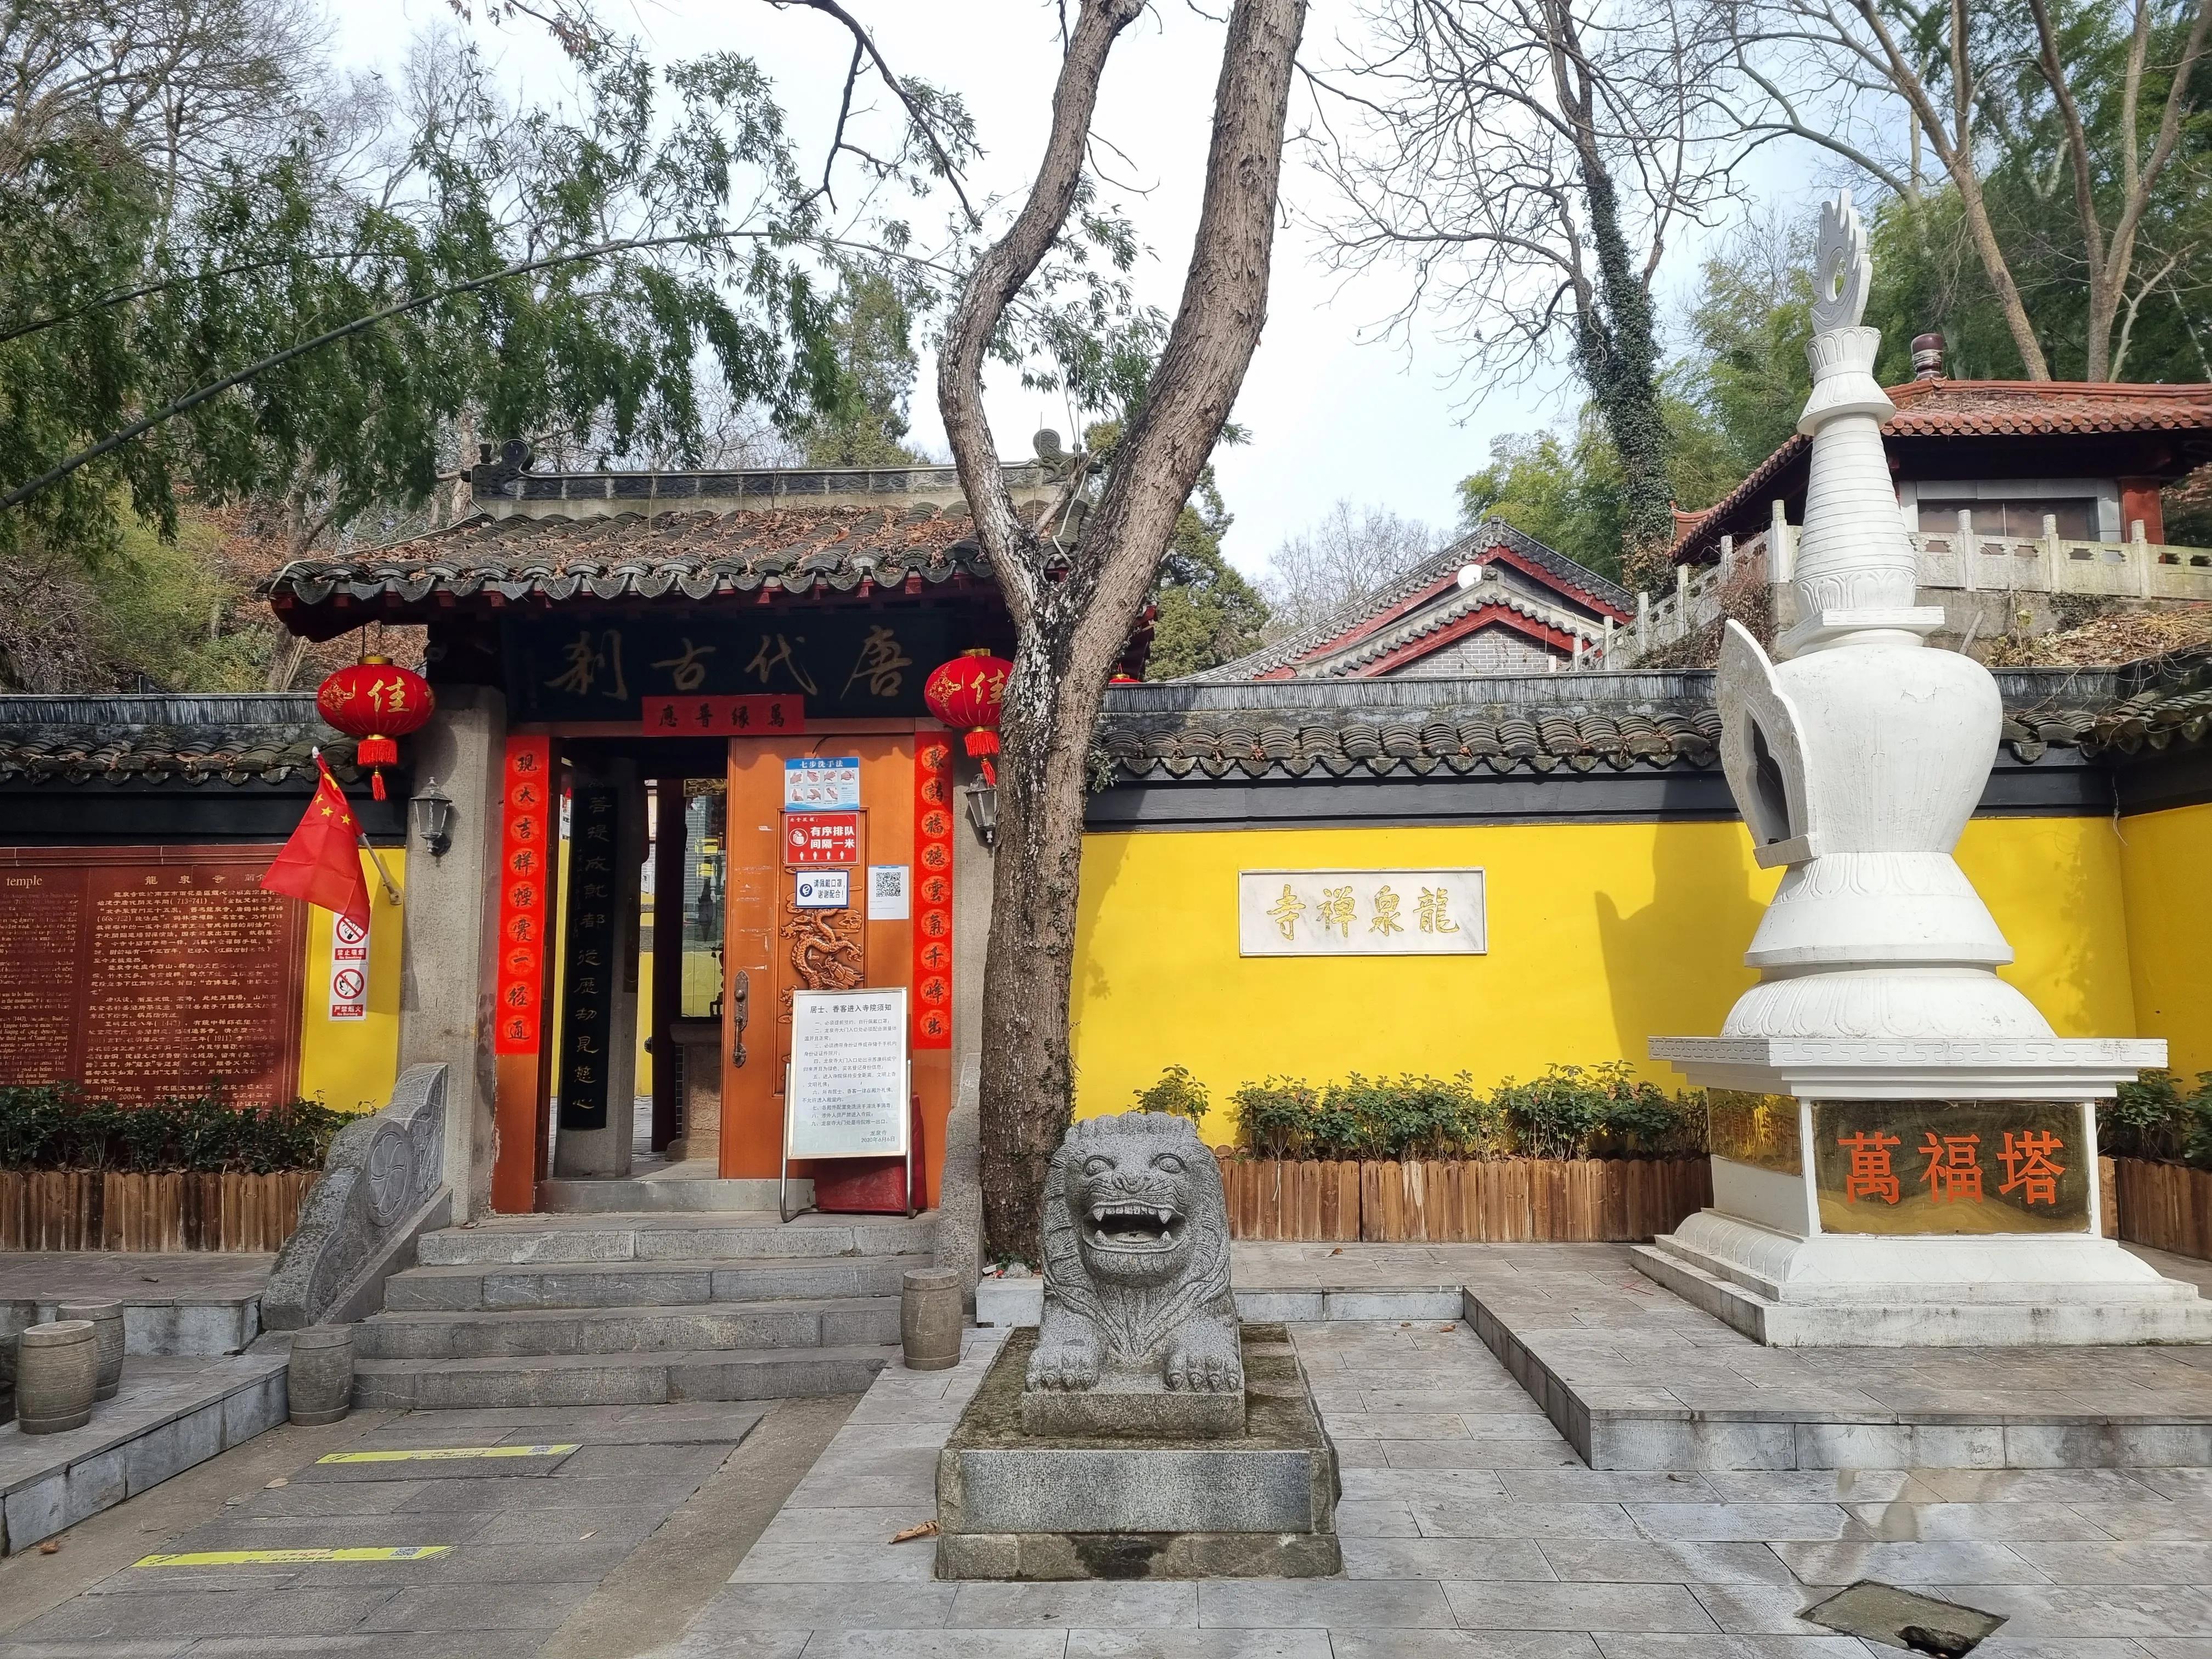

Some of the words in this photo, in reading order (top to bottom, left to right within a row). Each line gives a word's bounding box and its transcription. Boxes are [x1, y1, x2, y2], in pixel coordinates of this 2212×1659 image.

[970, 668, 1005, 704] 佳
[367, 676, 410, 713] 佳
[799, 760, 843, 768] 七步洗手法
[810, 826, 855, 836] 有序排队
[810, 838, 855, 849] 间隔一米
[6, 875, 43, 888] temple
[810, 1004, 891, 1014] 居士、香客进入寺院须知
[1838, 1130, 2066, 1205] 萬福塔
